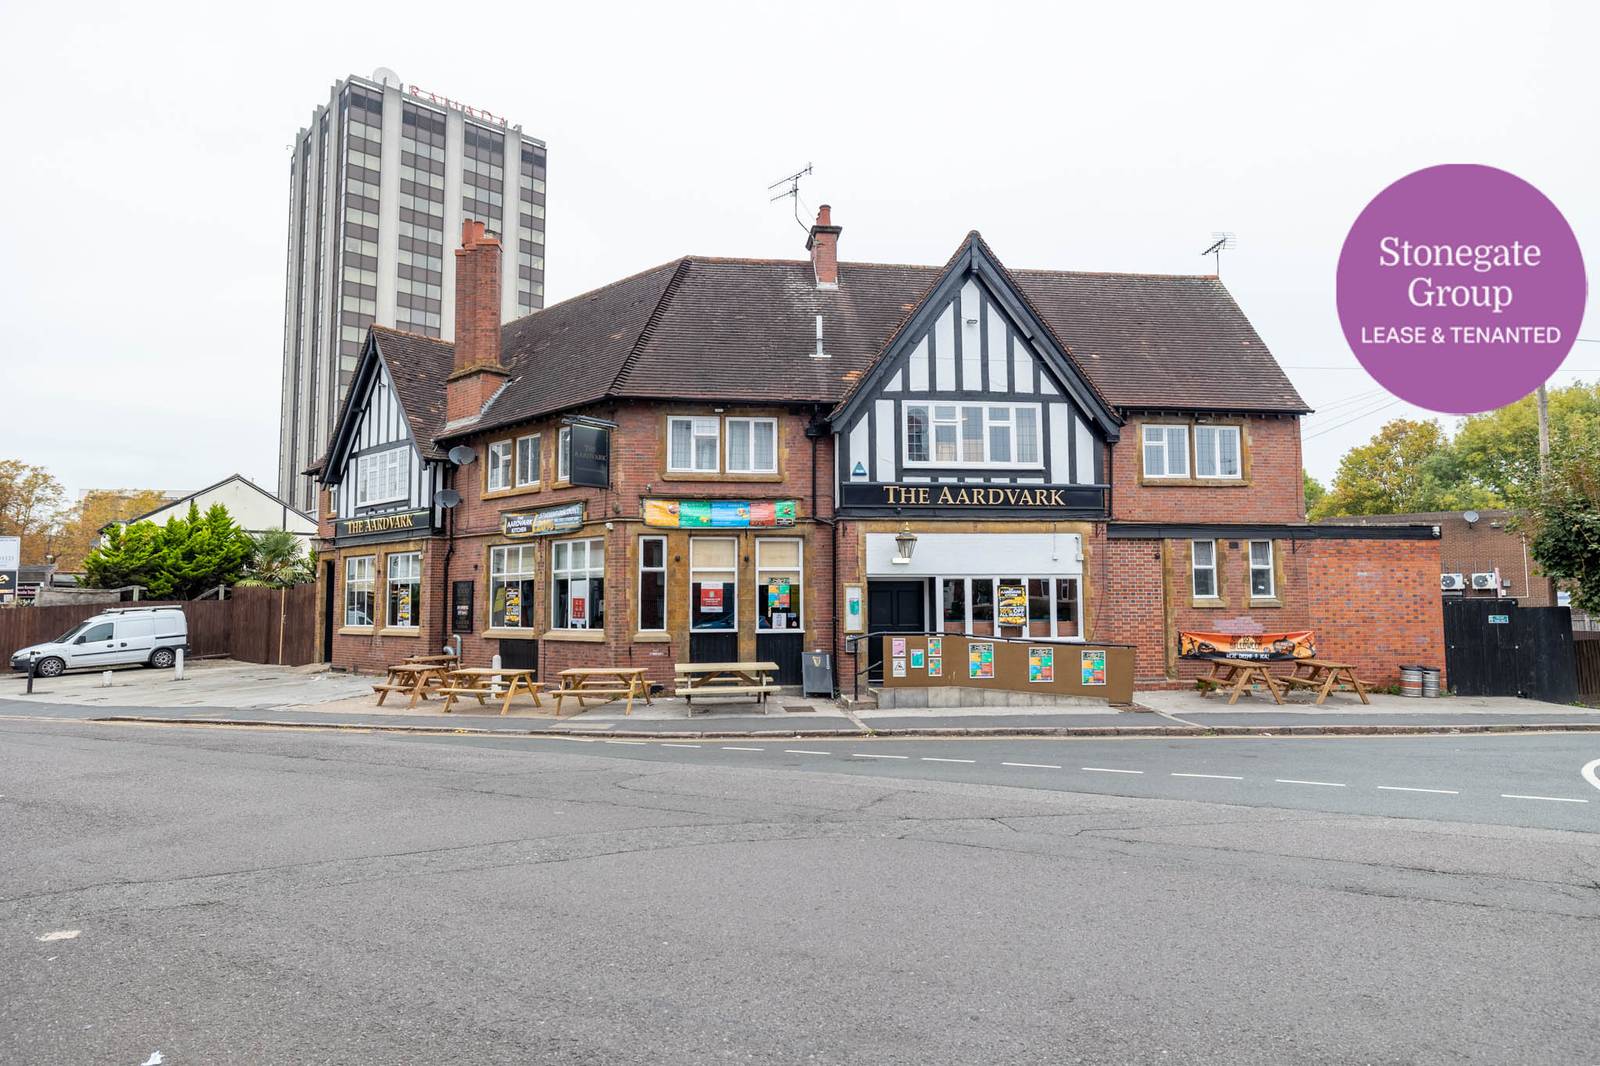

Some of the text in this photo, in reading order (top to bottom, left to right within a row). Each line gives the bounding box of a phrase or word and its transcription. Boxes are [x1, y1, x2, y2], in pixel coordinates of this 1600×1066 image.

[883, 485, 1066, 506] THE AARDVARK
[347, 514, 413, 534] THE AARDVARK
